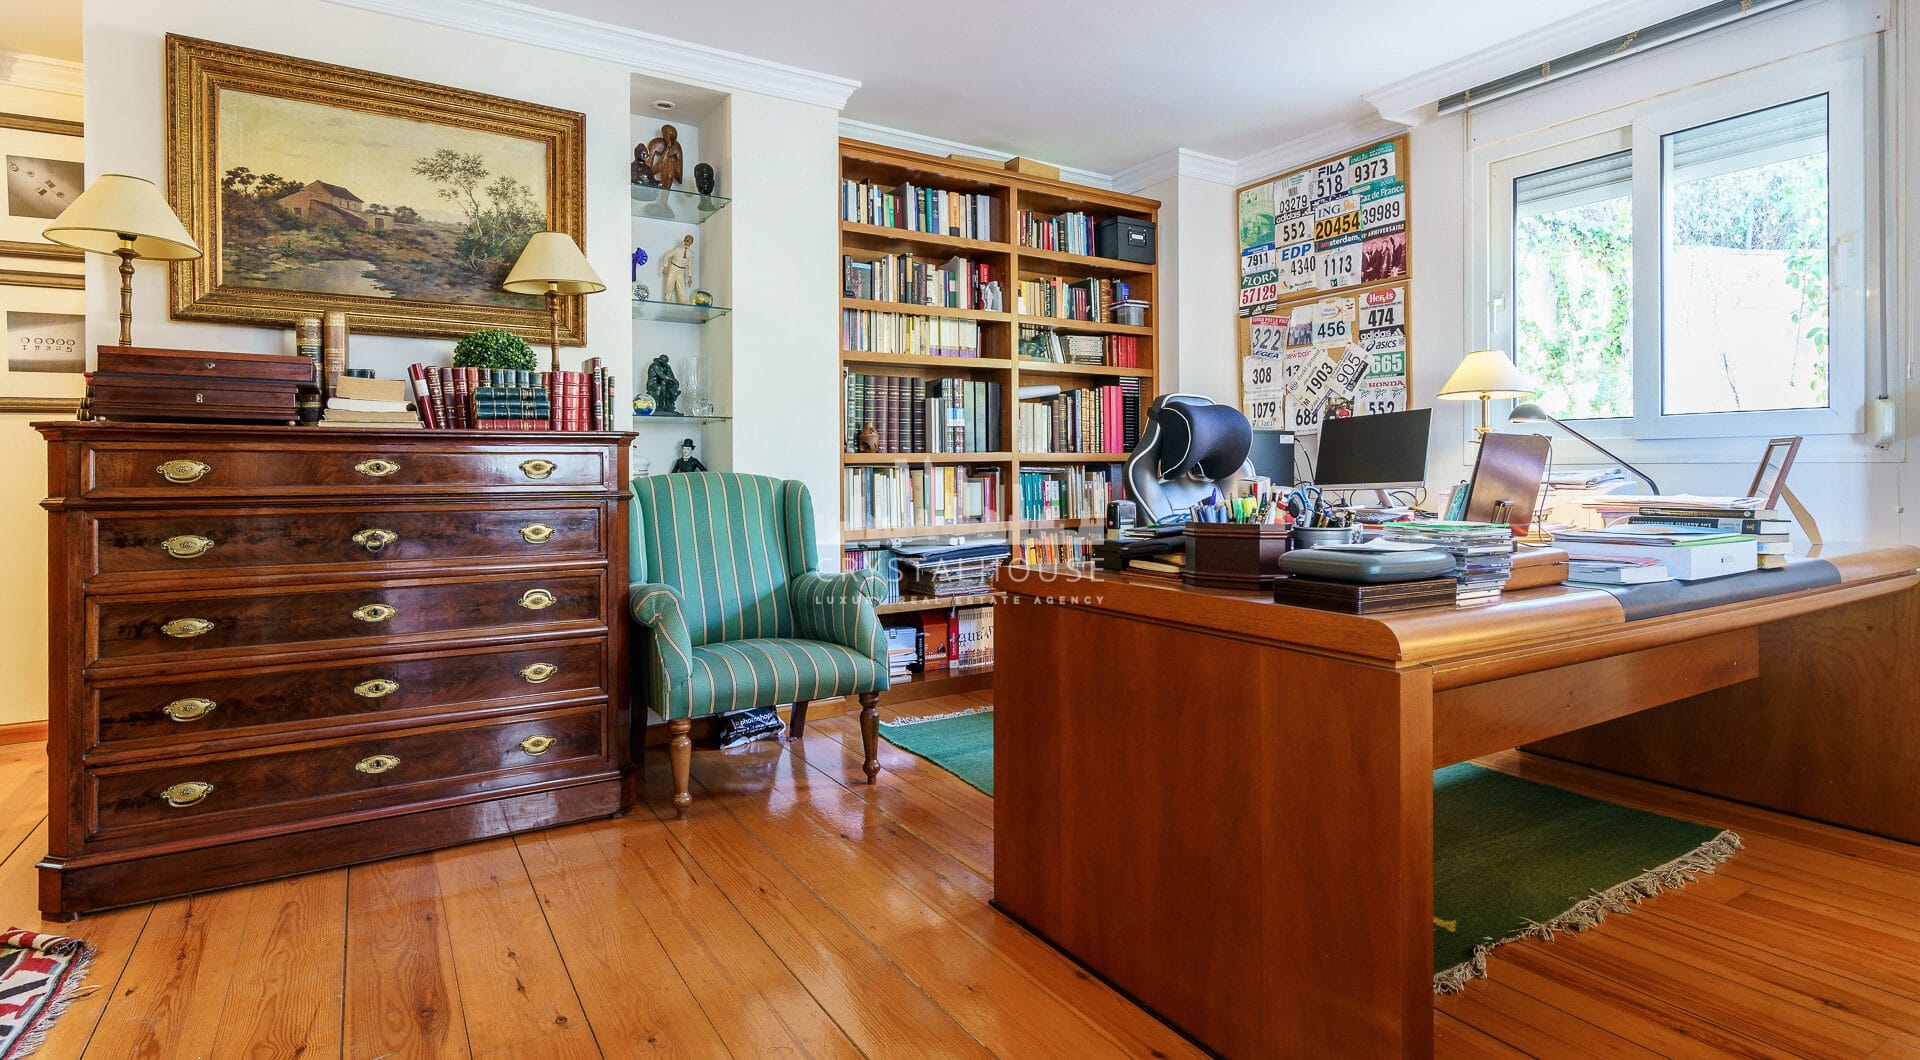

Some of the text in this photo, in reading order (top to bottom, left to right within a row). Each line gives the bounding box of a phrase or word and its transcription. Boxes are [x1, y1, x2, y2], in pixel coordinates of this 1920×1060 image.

[1318, 161, 1346, 179] FILA
[1354, 158, 1389, 183] 9373
[1317, 174, 1343, 198] 518
[1371, 190, 1380, 199] de
[1380, 184, 1404, 197] France
[1279, 194, 1308, 214] 03279
[1318, 204, 1341, 218] ING
[1362, 201, 1400, 226] 39989
[1283, 220, 1306, 242] 552
[1315, 211, 1360, 240] 20454
[1247, 252, 1269, 268] 7911
[1281, 243, 1312, 262] EDP
[1290, 255, 1316, 277] 4340
[1324, 254, 1352, 277] 1113
[1242, 269, 1277, 287] FLORA
[1241, 283, 1277, 305] 57129
[1367, 307, 1395, 327] 474
[1252, 327, 1282, 351] 322
[1317, 320, 1346, 339] 456
[1360, 328, 1392, 342] adidas
[1375, 339, 1398, 350] asics
[1336, 354, 1361, 386] 905
[1367, 354, 1403, 375] 665
[1252, 366, 1272, 385] 308
[1305, 362, 1334, 396] 1903
[1368, 380, 1406, 388] HONDA
[1252, 401, 1276, 419] 1079
